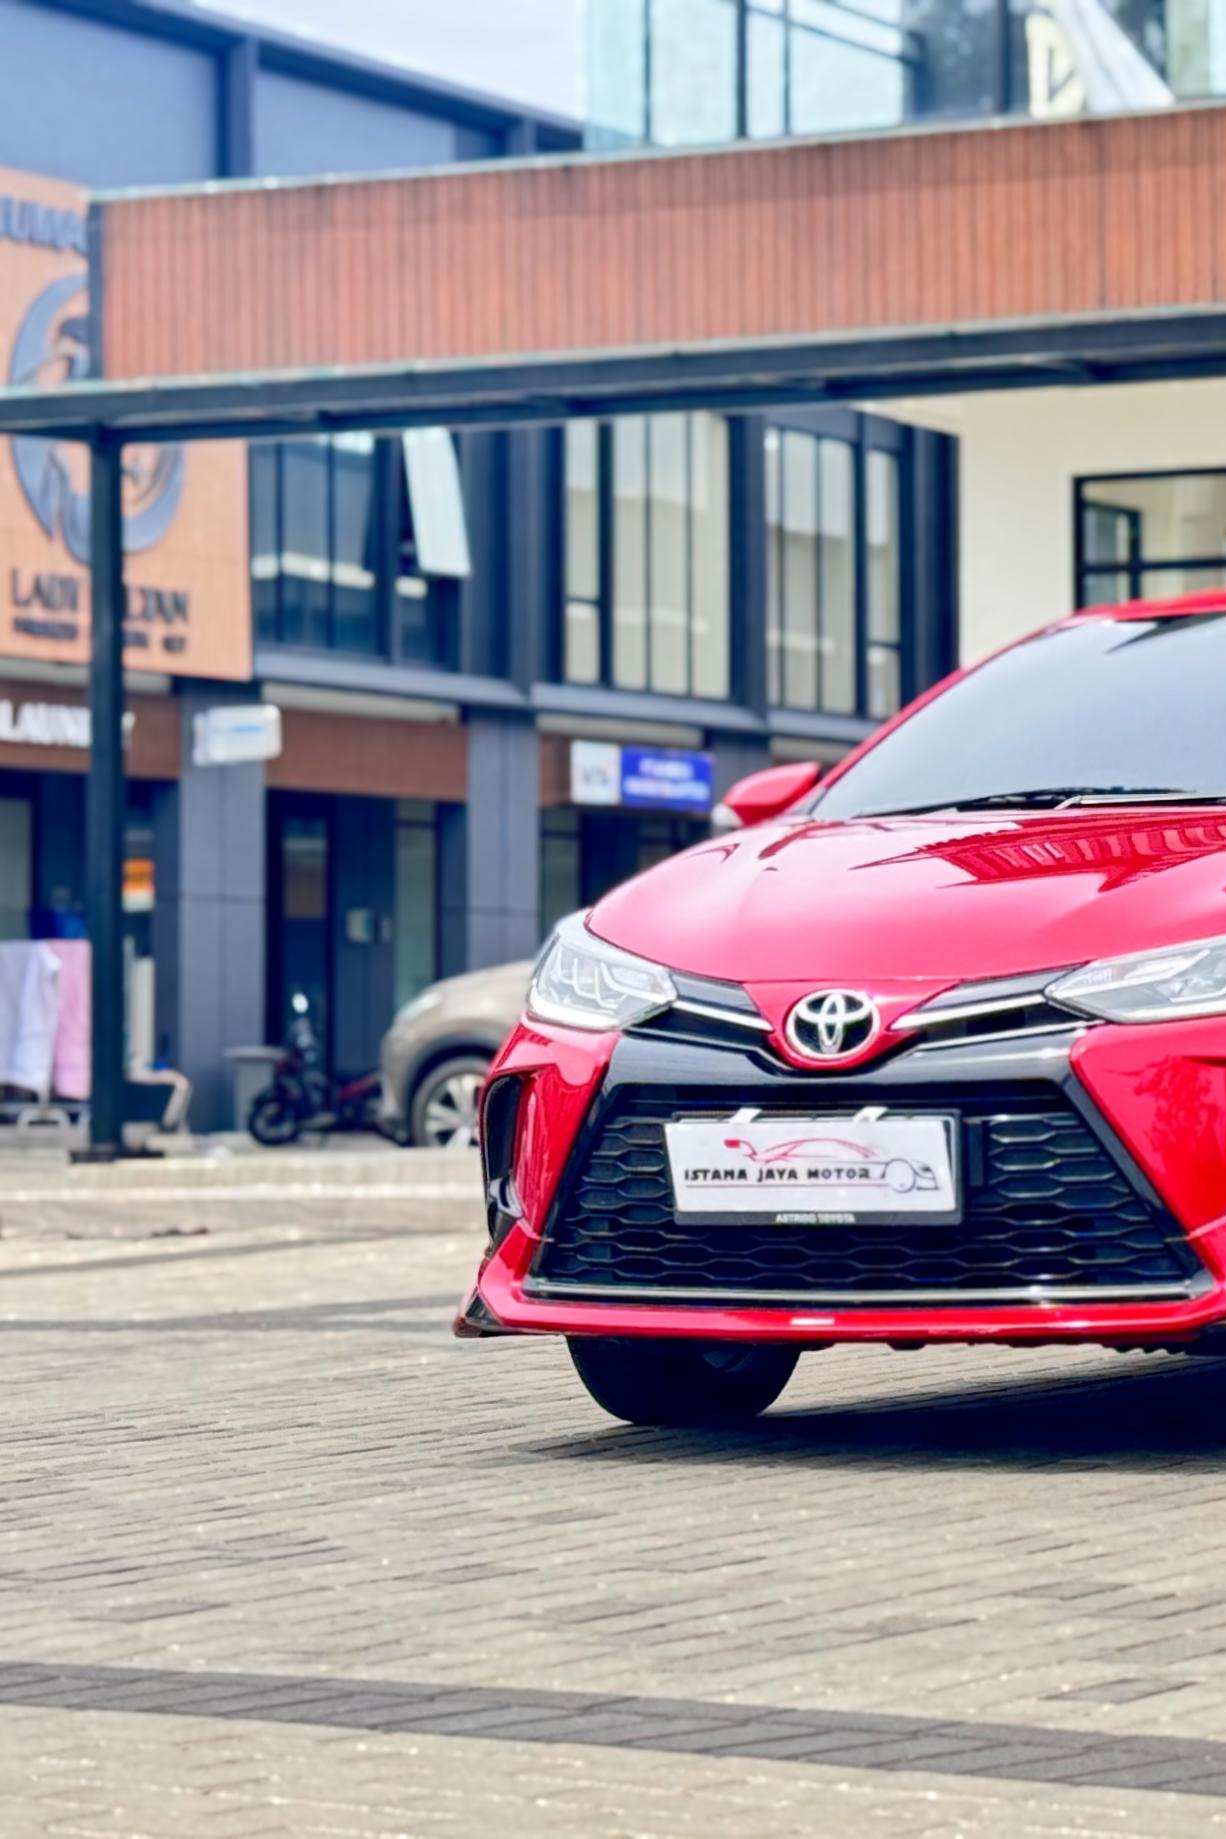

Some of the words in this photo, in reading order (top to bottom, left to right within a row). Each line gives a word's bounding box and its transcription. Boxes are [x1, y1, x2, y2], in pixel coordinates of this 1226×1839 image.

[684, 1169, 748, 1181] ISTANA
[757, 1168, 799, 1183] JAYA
[807, 1168, 870, 1180] MOTOR
